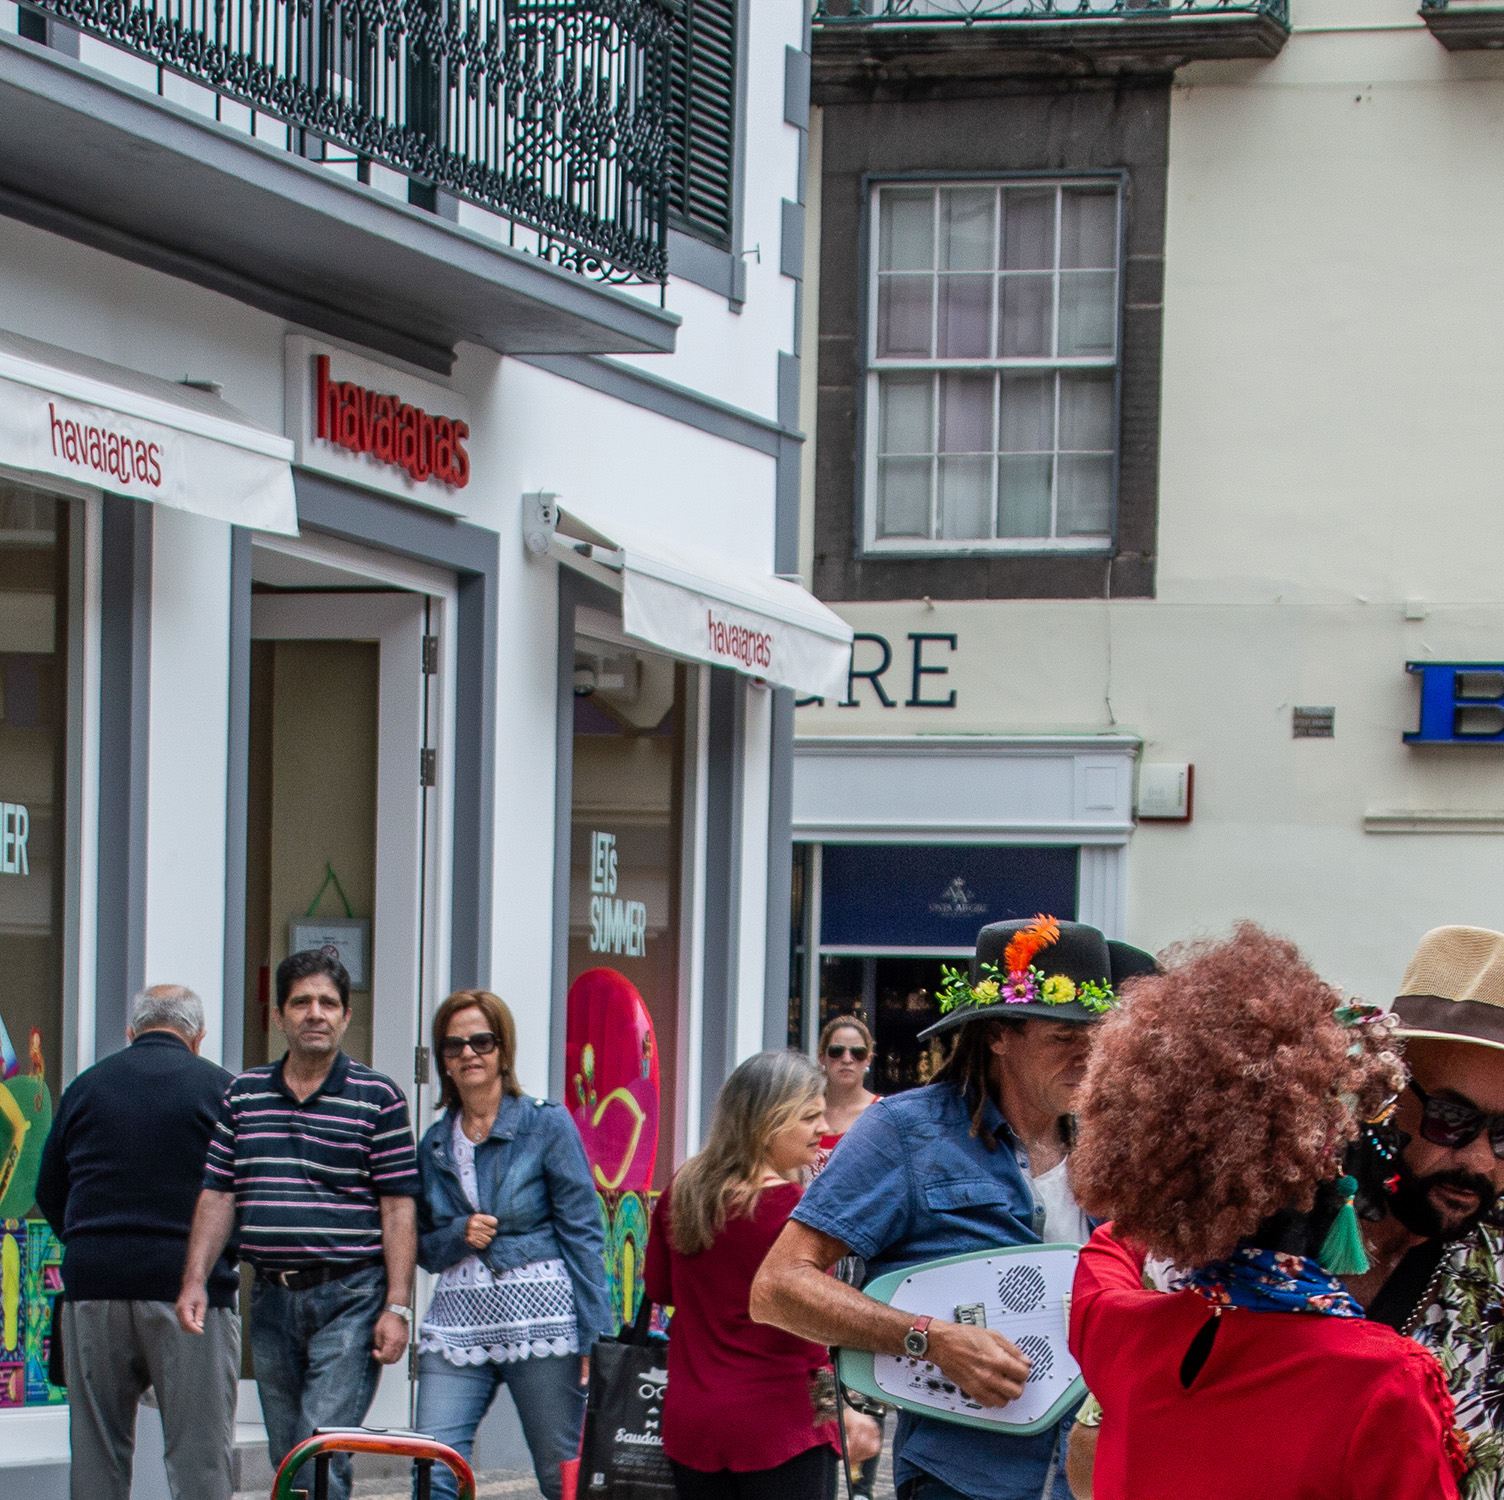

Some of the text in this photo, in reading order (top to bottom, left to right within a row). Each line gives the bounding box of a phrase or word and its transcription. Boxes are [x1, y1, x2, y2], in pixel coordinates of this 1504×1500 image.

[48, 402, 162, 488] havaianas
[317, 354, 471, 489] havaianas
[708, 609, 772, 668] havaianas
[589, 895, 647, 958] SUMMER
